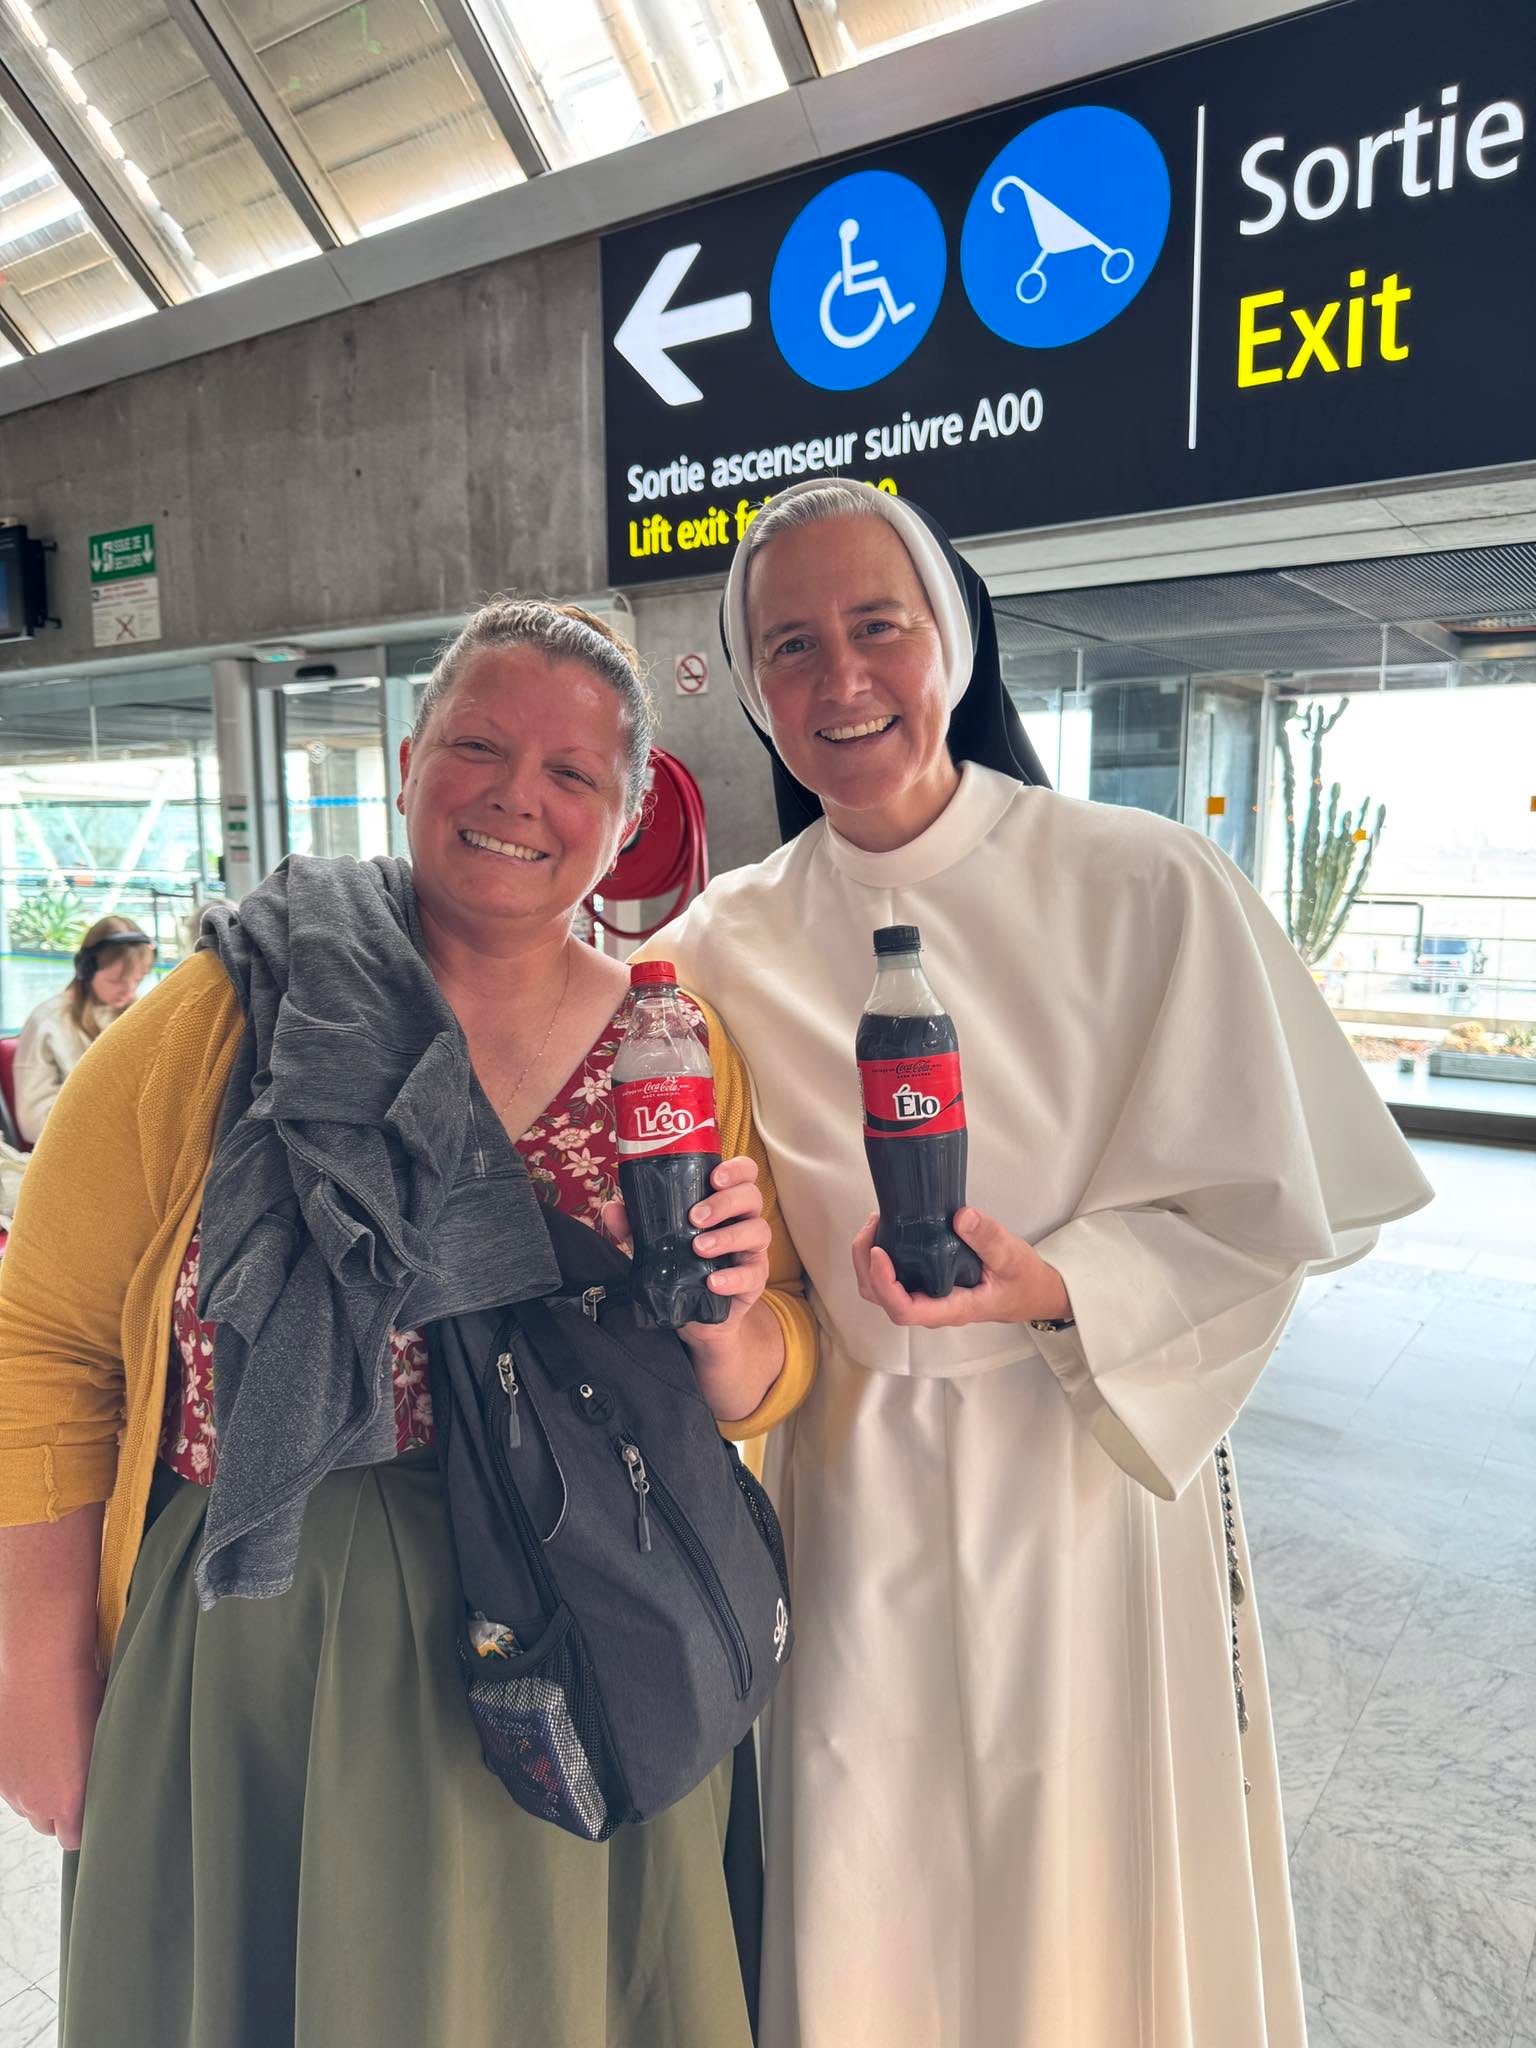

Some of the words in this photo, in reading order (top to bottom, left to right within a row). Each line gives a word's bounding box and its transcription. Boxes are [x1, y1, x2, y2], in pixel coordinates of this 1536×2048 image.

[1239, 85, 1524, 236] Sortie
[1238, 269, 1412, 388] Exit
[627, 454, 705, 503] Sortie
[711, 432, 858, 488] ascenseur
[864, 411, 964, 461] suivre
[969, 388, 1044, 441] A00
[629, 513, 672, 557] Lift
[677, 506, 729, 550] exit
[634, 1101, 694, 1137] Léo
[893, 1084, 941, 1120] Élo
